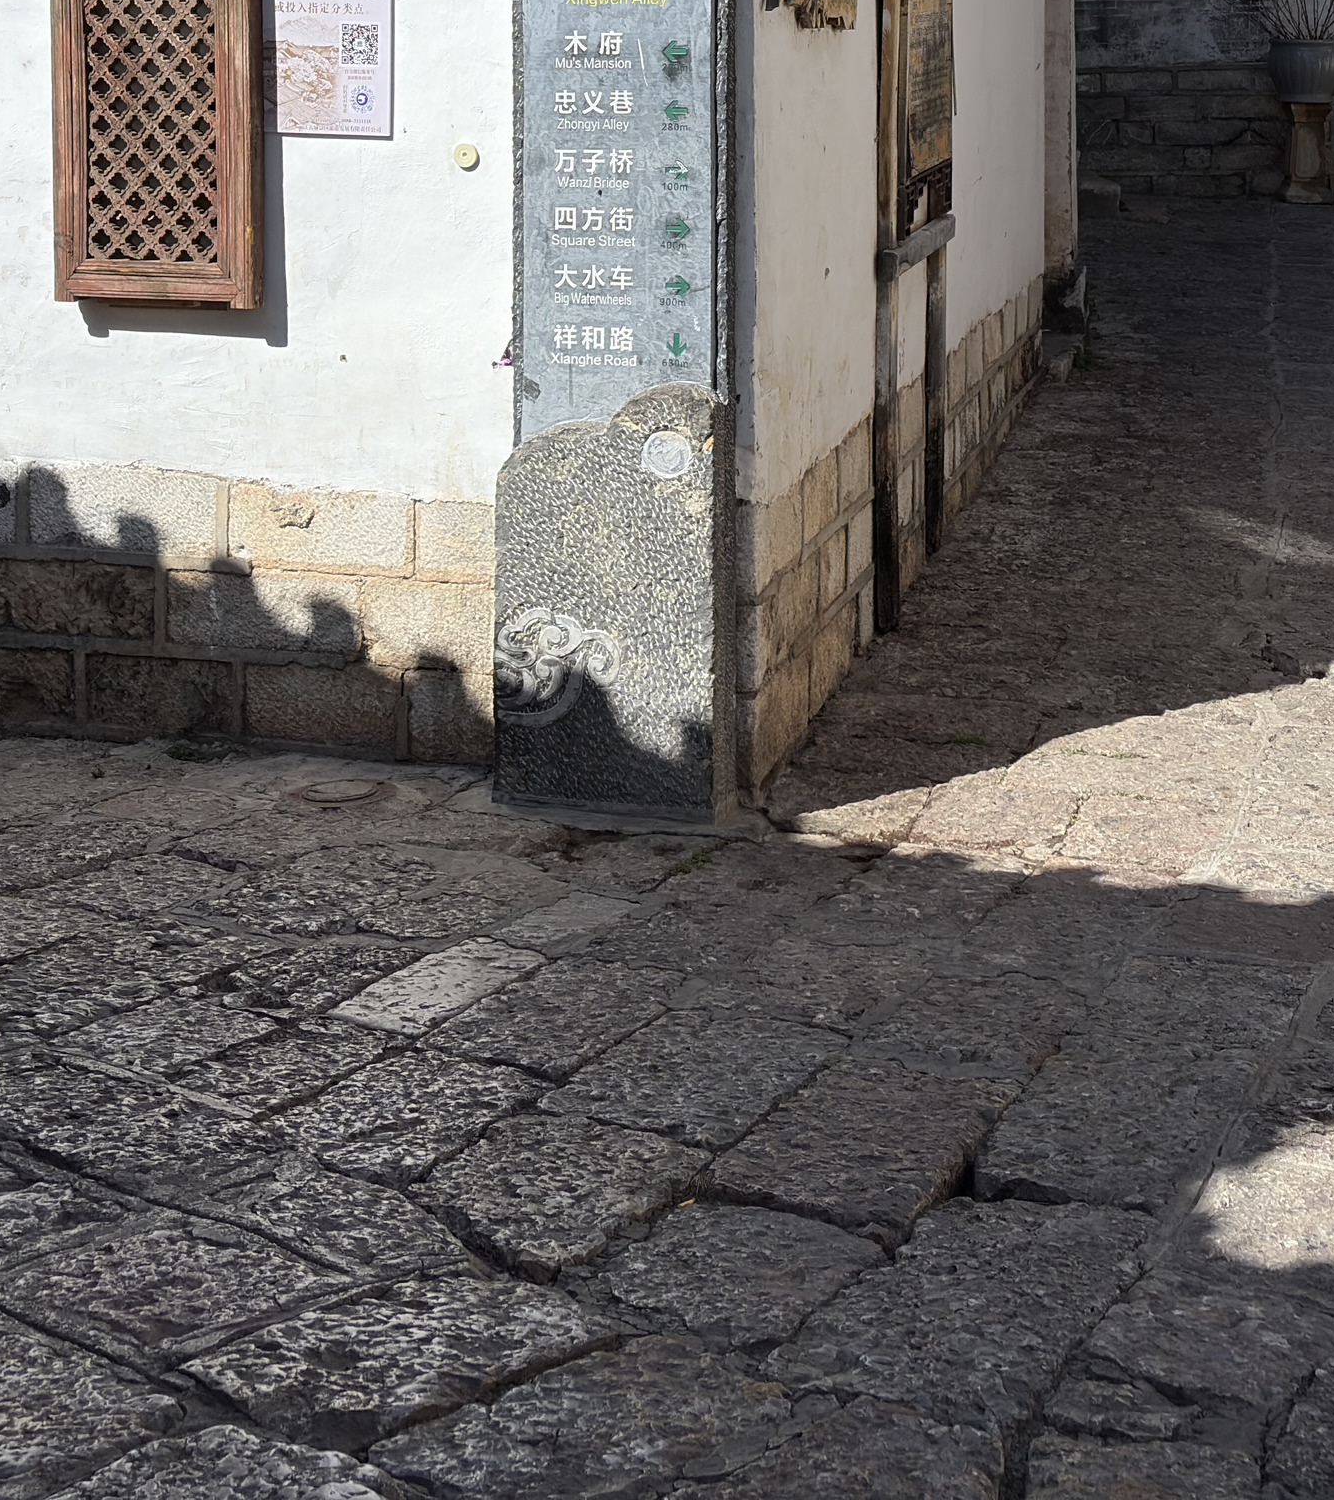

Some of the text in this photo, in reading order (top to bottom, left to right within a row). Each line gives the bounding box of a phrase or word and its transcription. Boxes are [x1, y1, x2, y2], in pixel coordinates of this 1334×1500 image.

[564, 30, 623, 55] 木府
[555, 57, 632, 69] Mu's Mansion
[553, 90, 634, 114] 忠义巷
[556, 118, 630, 132] Zhongyi Alley
[661, 123, 688, 131] 280m
[554, 149, 634, 175] 万子桥
[557, 176, 630, 190] Wanzi Bridge
[662, 183, 688, 191] 100m
[554, 206, 634, 232] 四方街
[551, 234, 636, 247] Square Street
[554, 264, 634, 290] 大水车
[554, 292, 632, 306] Big Waterwheels
[659, 299, 686, 307] 900m
[553, 324, 634, 351] 祥和路
[551, 353, 637, 367] Xianghe Road
